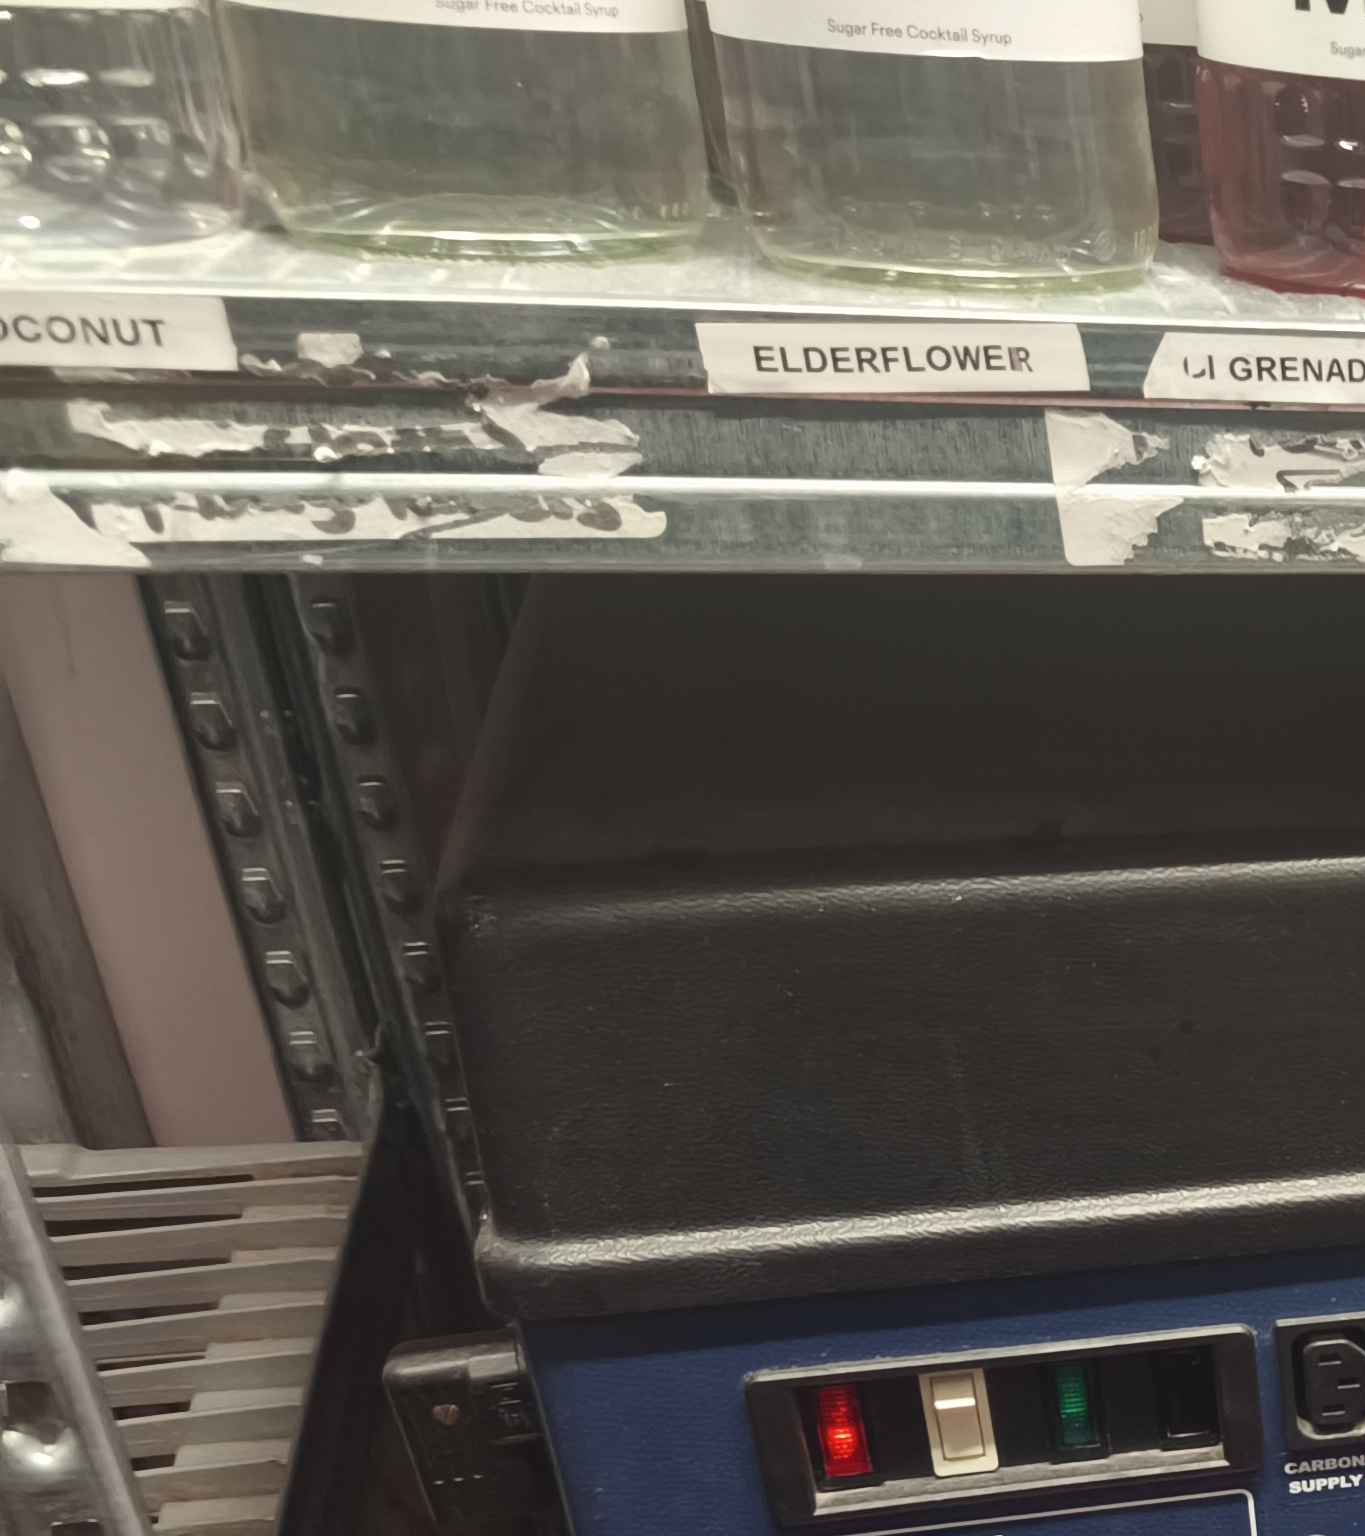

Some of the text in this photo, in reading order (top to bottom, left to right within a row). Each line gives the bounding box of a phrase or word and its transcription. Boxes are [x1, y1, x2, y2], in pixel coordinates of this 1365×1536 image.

[827, 18, 1012, 46] Sugar Free Cocktail Syrup
[0, 315, 165, 347] CONUT
[753, 344, 1034, 374] ELDERFLOWER
[1288, 1473, 1363, 1494] SUPPLY
